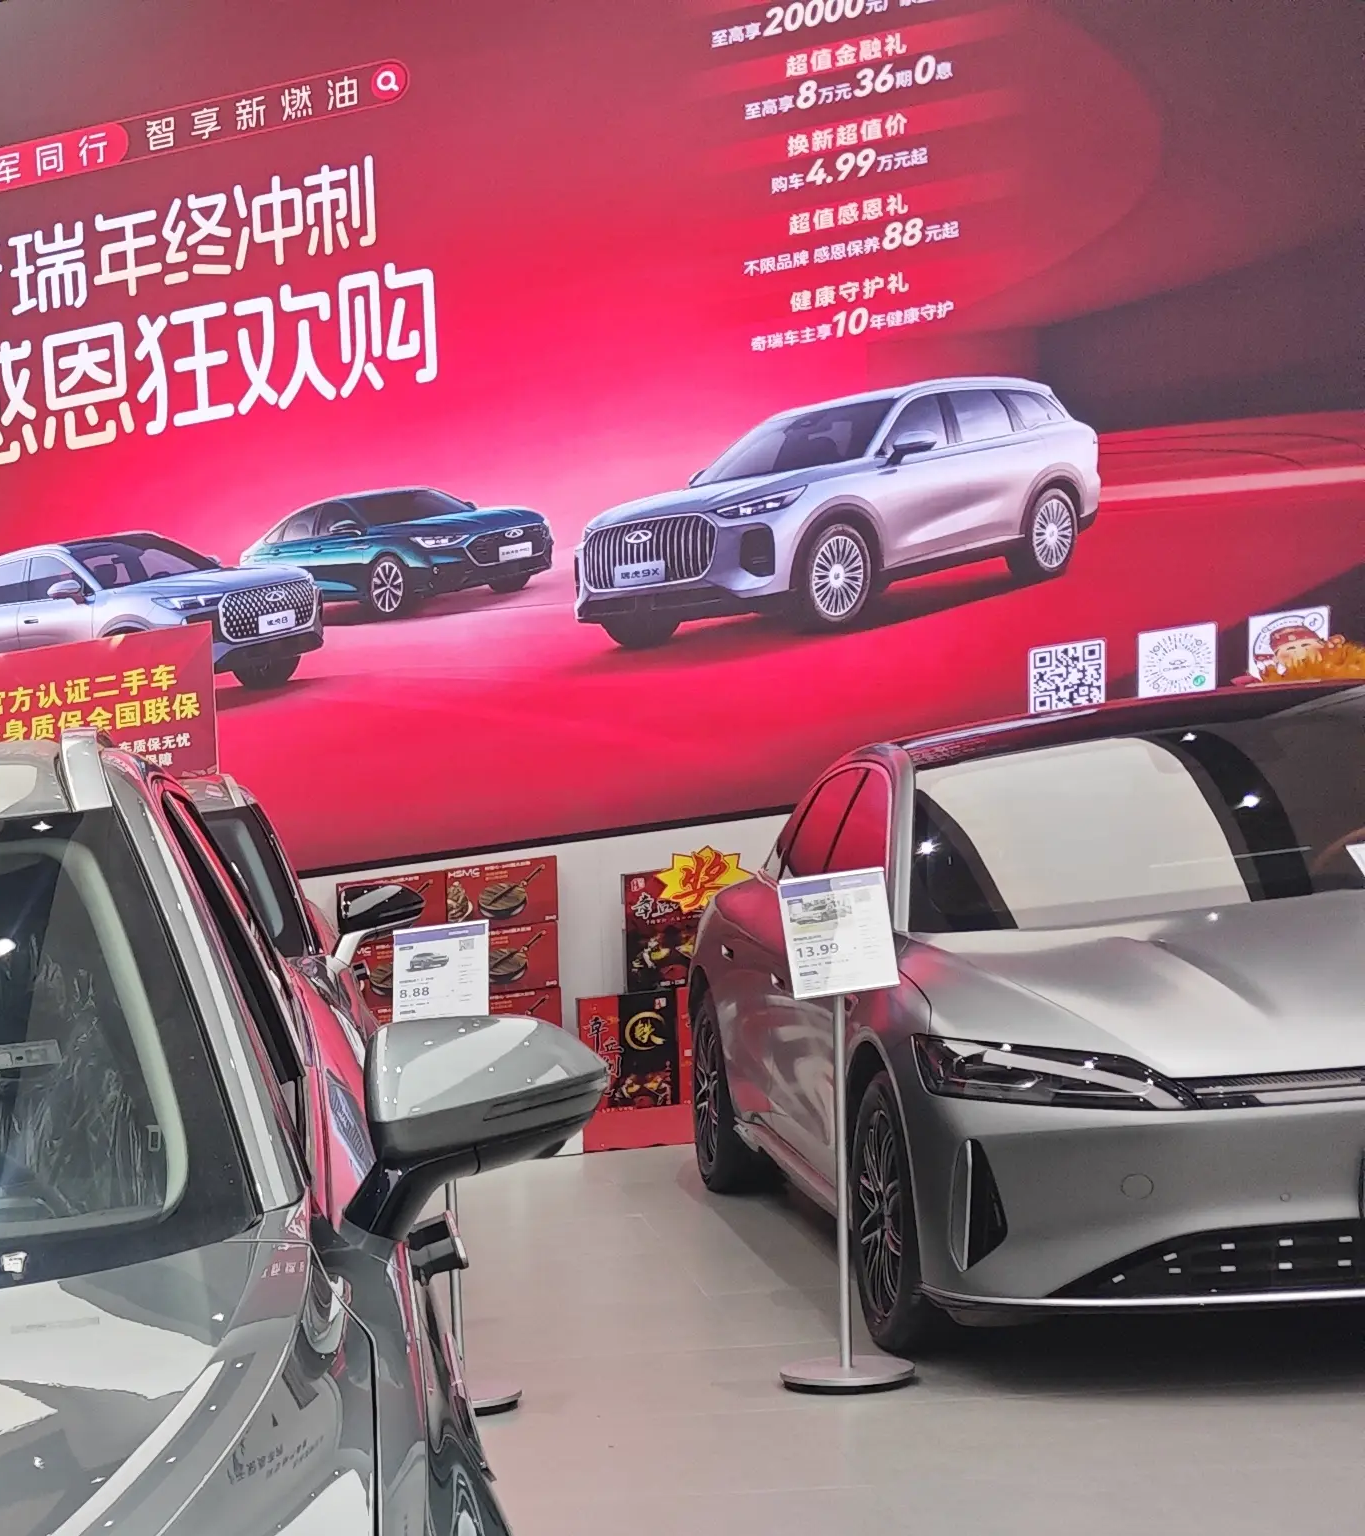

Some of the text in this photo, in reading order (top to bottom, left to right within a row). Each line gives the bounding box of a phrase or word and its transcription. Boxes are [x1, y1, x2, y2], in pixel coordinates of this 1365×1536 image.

[785, 33, 907, 78] 超值金融礼
[744, 54, 953, 120] 至高享8万元36期0息
[145, 75, 360, 151] 智享新燃油
[787, 113, 908, 157] 换新超值价
[771, 147, 928, 194] 购车4.99万元起
[788, 193, 908, 236] 超值感恩礼
[744, 217, 959, 276] 不限品牌 感恩保养88元起
[790, 272, 909, 313] 健康守护礼
[751, 300, 954, 352] 奇瑞车主享10年健康守护
[796, 943, 839, 958] 13.99
[400, 987, 429, 998] 8.88
